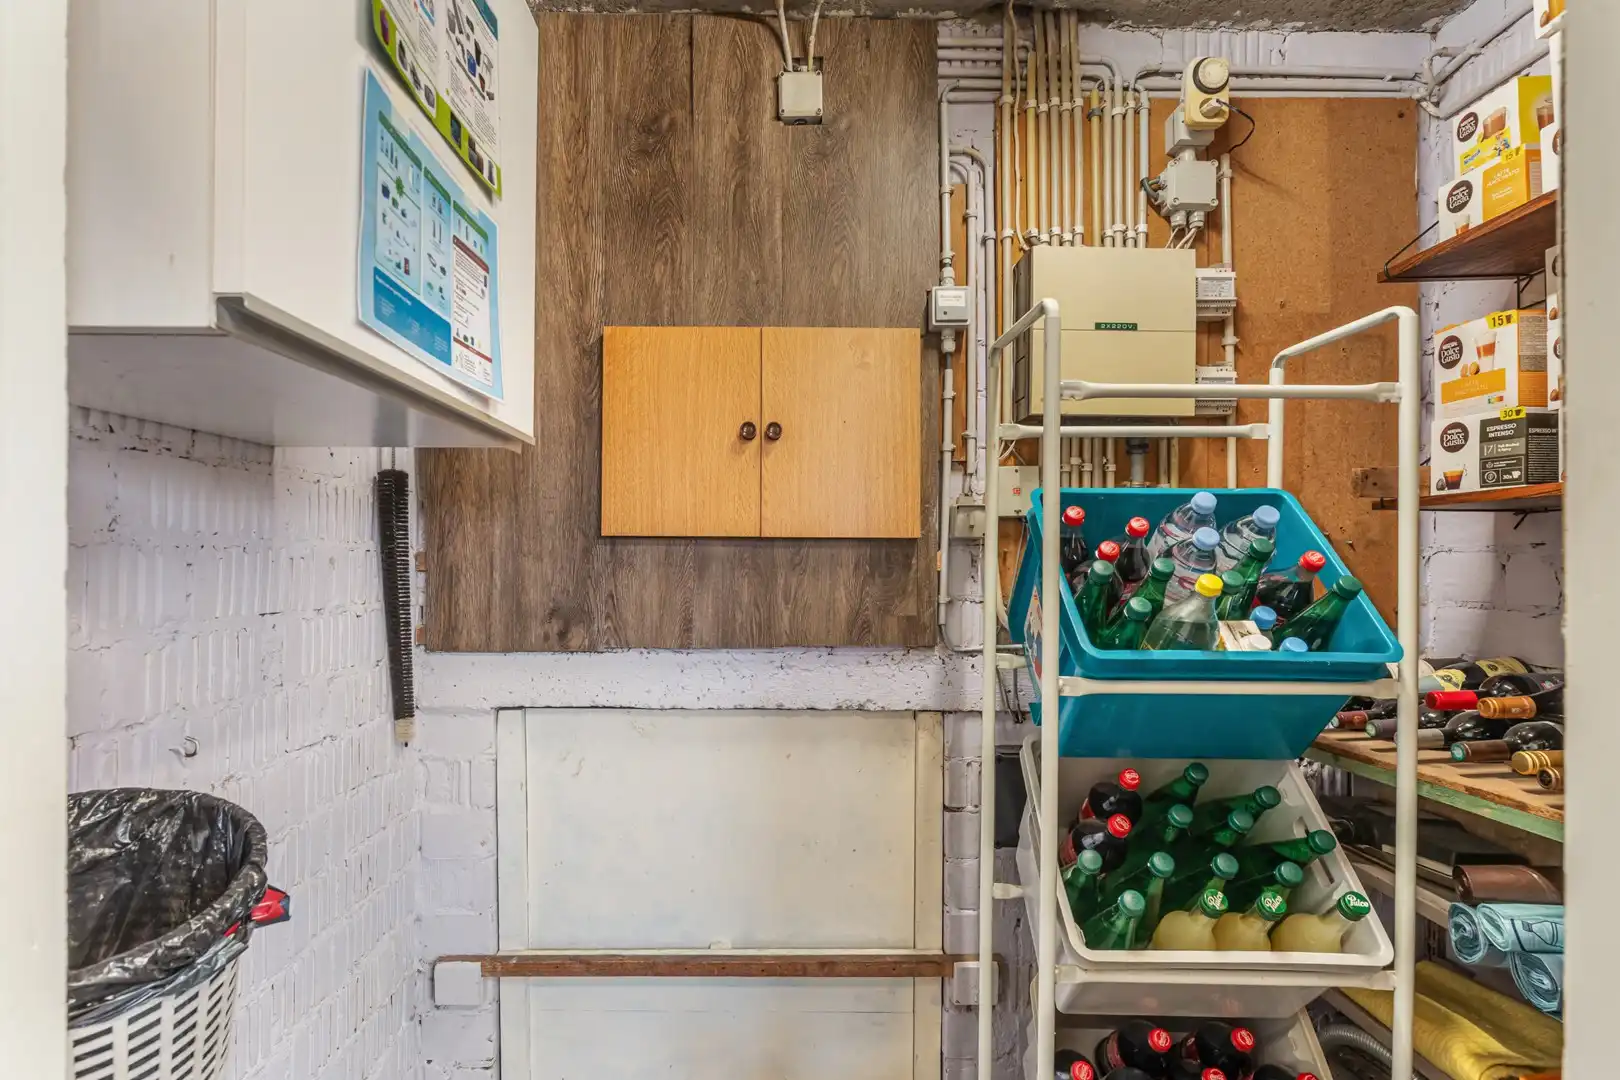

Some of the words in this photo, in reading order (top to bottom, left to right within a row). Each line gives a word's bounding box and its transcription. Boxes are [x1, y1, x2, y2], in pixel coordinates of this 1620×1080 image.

[1449, 189, 1469, 203] Dolce
[1449, 196, 1470, 209] Gusto
[1491, 314, 1504, 327] 15
[1441, 346, 1460, 359] Dolce
[1441, 353, 1460, 364] Gusto
[1502, 409, 1513, 419] 30
[1486, 423, 1517, 432] ESPRESSO
[1488, 430, 1514, 438] INTENSO
[1443, 431, 1465, 441] Dolce
[1443, 438, 1465, 447] Gusto
[1207, 891, 1224, 910] Pulco
[1264, 895, 1283, 912] Pulco
[1347, 894, 1368, 908] Pulco
